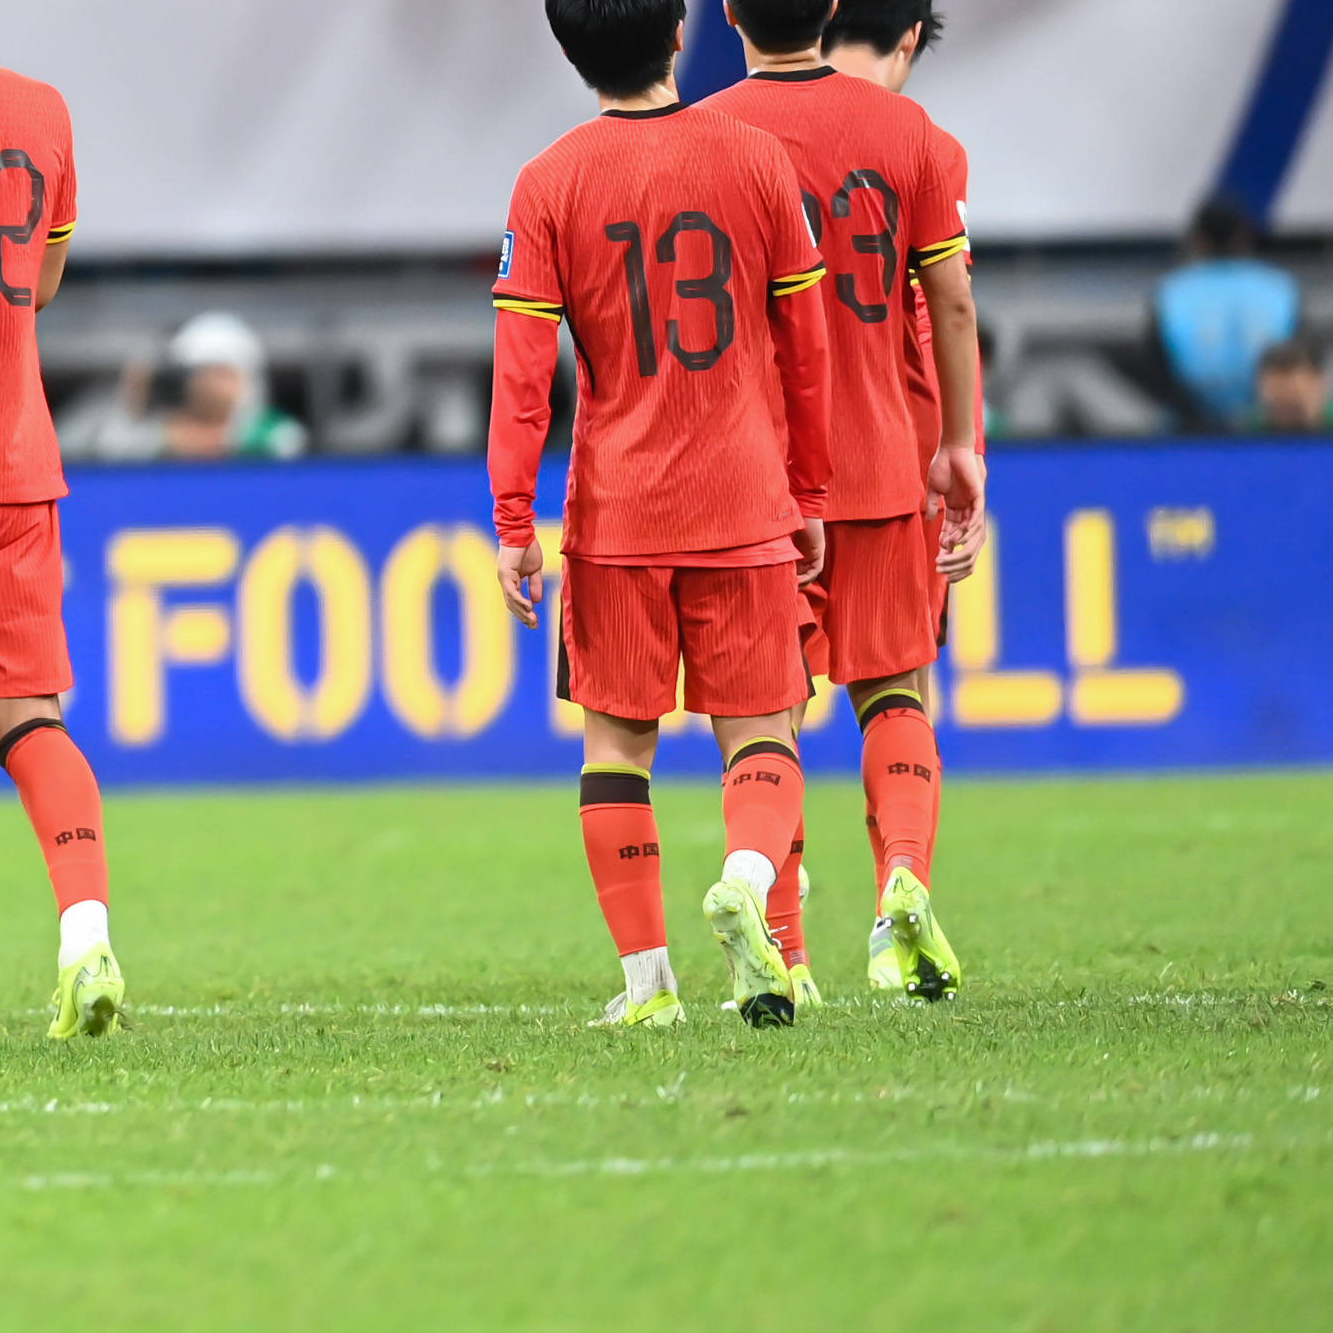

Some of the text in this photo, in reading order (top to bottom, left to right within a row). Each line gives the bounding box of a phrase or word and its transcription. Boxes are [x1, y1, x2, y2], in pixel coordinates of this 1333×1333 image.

[605, 211, 735, 378] 13
[801, 168, 899, 324] 3
[105, 506, 1186, 748] FOOLL
